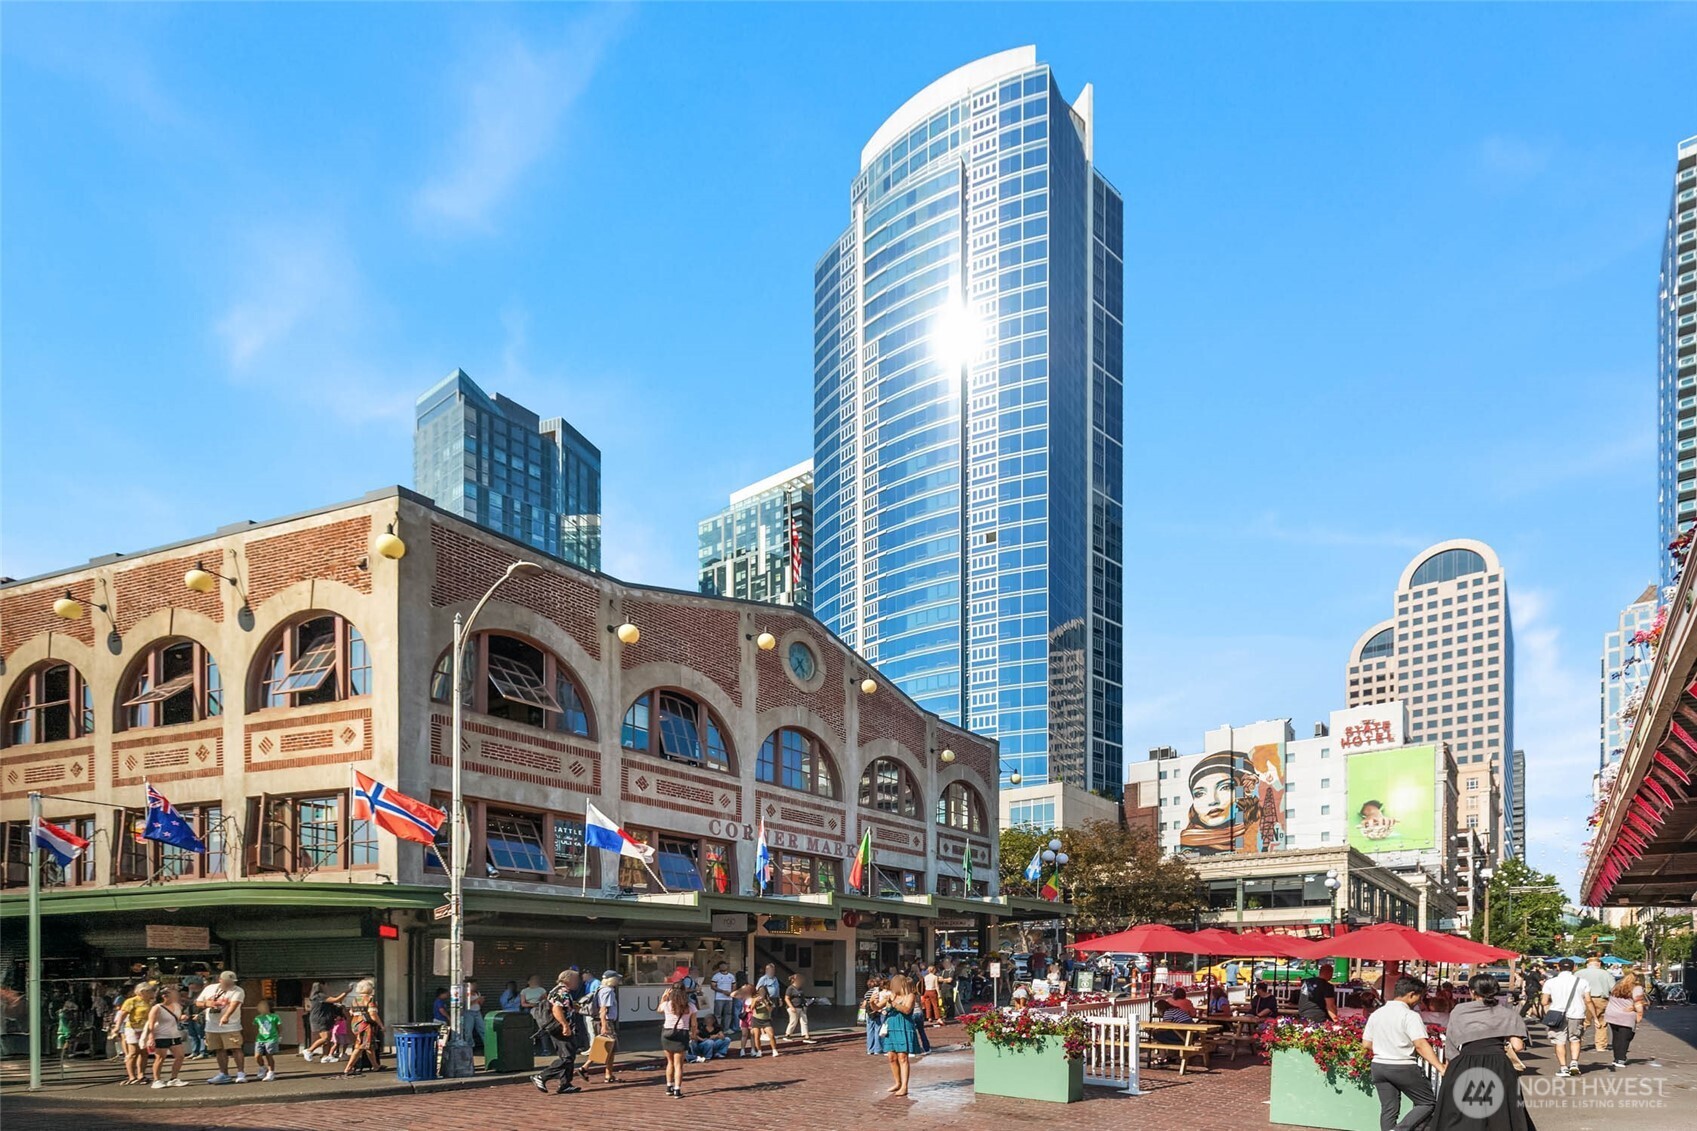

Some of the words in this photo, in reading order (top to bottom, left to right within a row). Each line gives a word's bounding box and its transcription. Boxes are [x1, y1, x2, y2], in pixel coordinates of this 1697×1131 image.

[1345, 720, 1391, 737] STATE
[1341, 731, 1395, 749] HOTEL
[806, 836, 879, 862] MARKT
